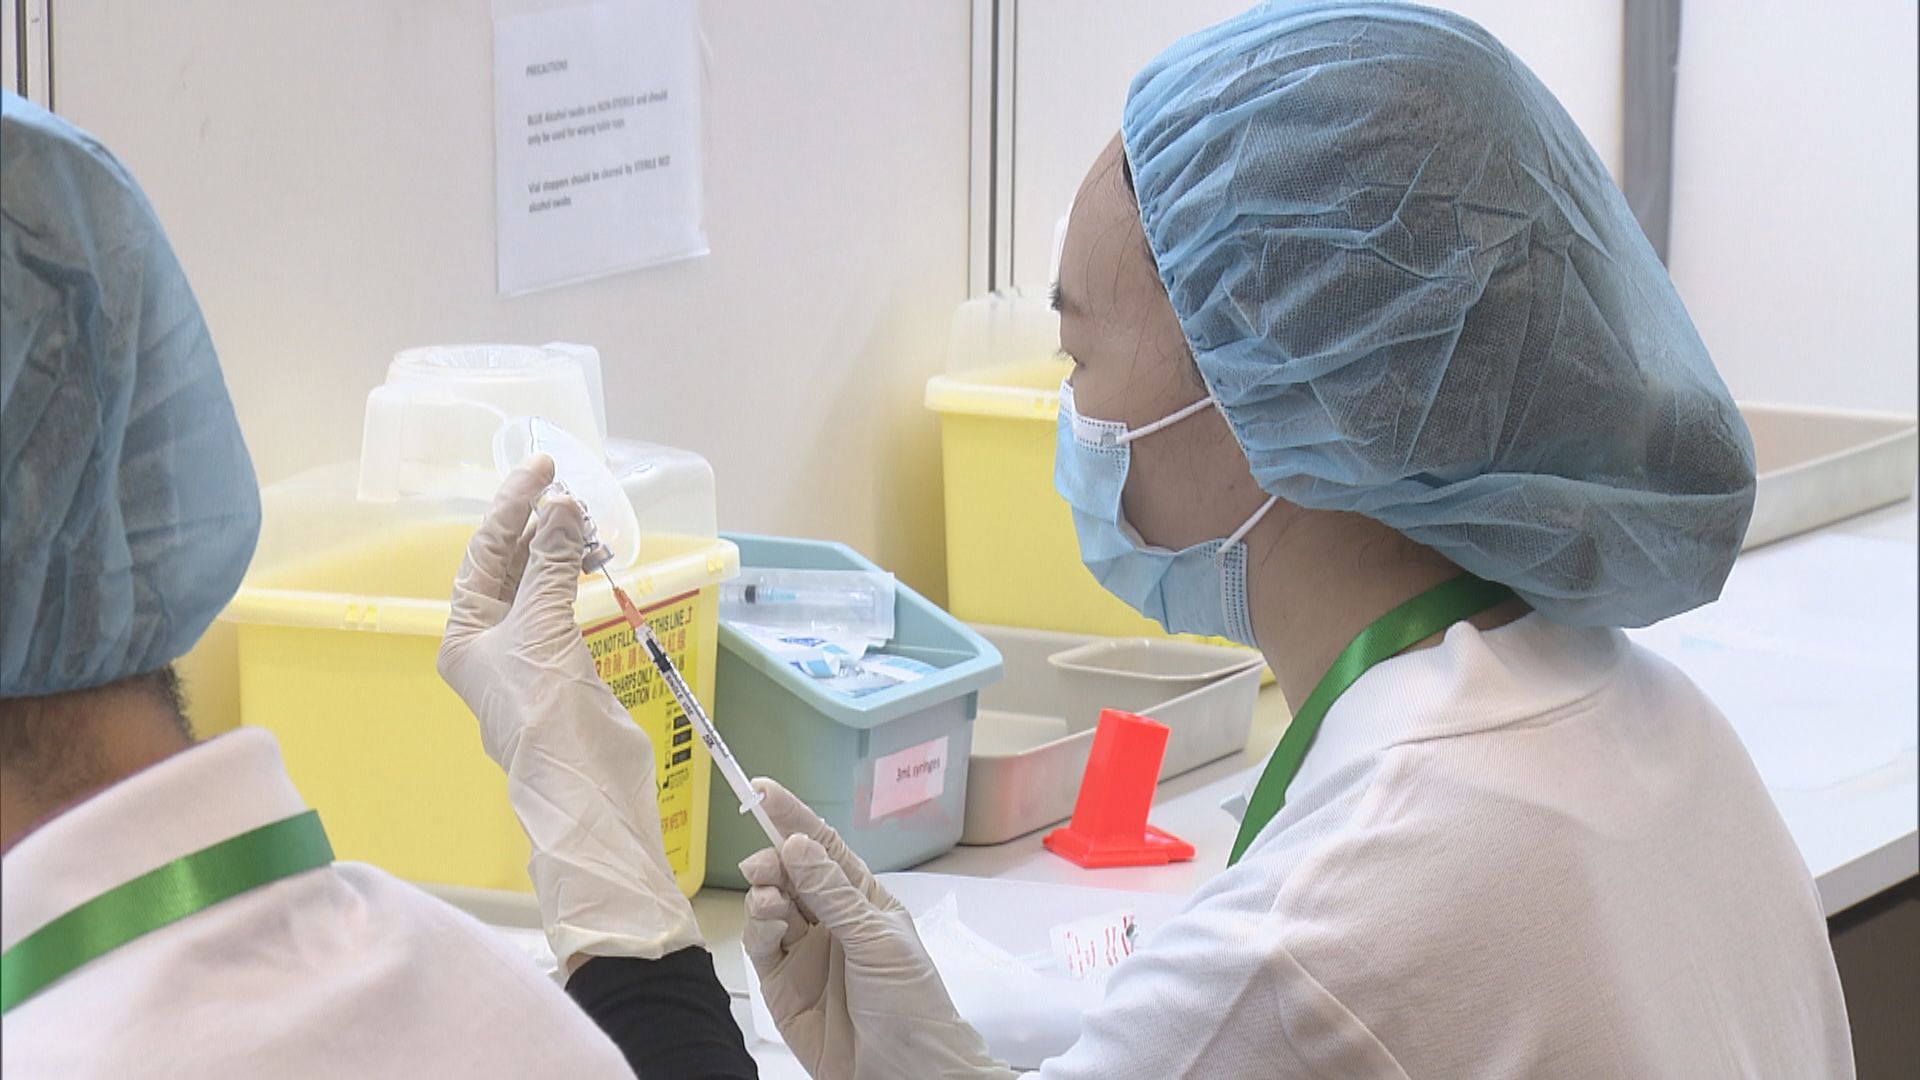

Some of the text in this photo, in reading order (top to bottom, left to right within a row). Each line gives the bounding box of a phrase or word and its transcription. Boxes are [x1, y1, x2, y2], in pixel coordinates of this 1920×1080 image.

[526, 60, 568, 76] PRECAUTIONS
[528, 113, 543, 126] BLUE
[636, 95, 647, 105] and
[648, 88, 668, 102] should
[527, 133, 541, 145] only
[542, 131, 550, 142] be
[551, 128, 566, 141] used
[528, 181, 541, 194] Vial
[571, 172, 591, 186] should
[592, 170, 600, 182] be
[625, 163, 632, 175] by
[634, 157, 656, 173] STERILE
[529, 198, 551, 213] alcohol
[603, 634, 616, 656] NOT
[617, 630, 631, 649] FILL
[655, 614, 669, 635] THIS
[670, 608, 684, 630] LINE
[612, 671, 636, 696] SHARPS
[636, 665, 653, 687] ONLY
[913, 757, 941, 776] syringes
